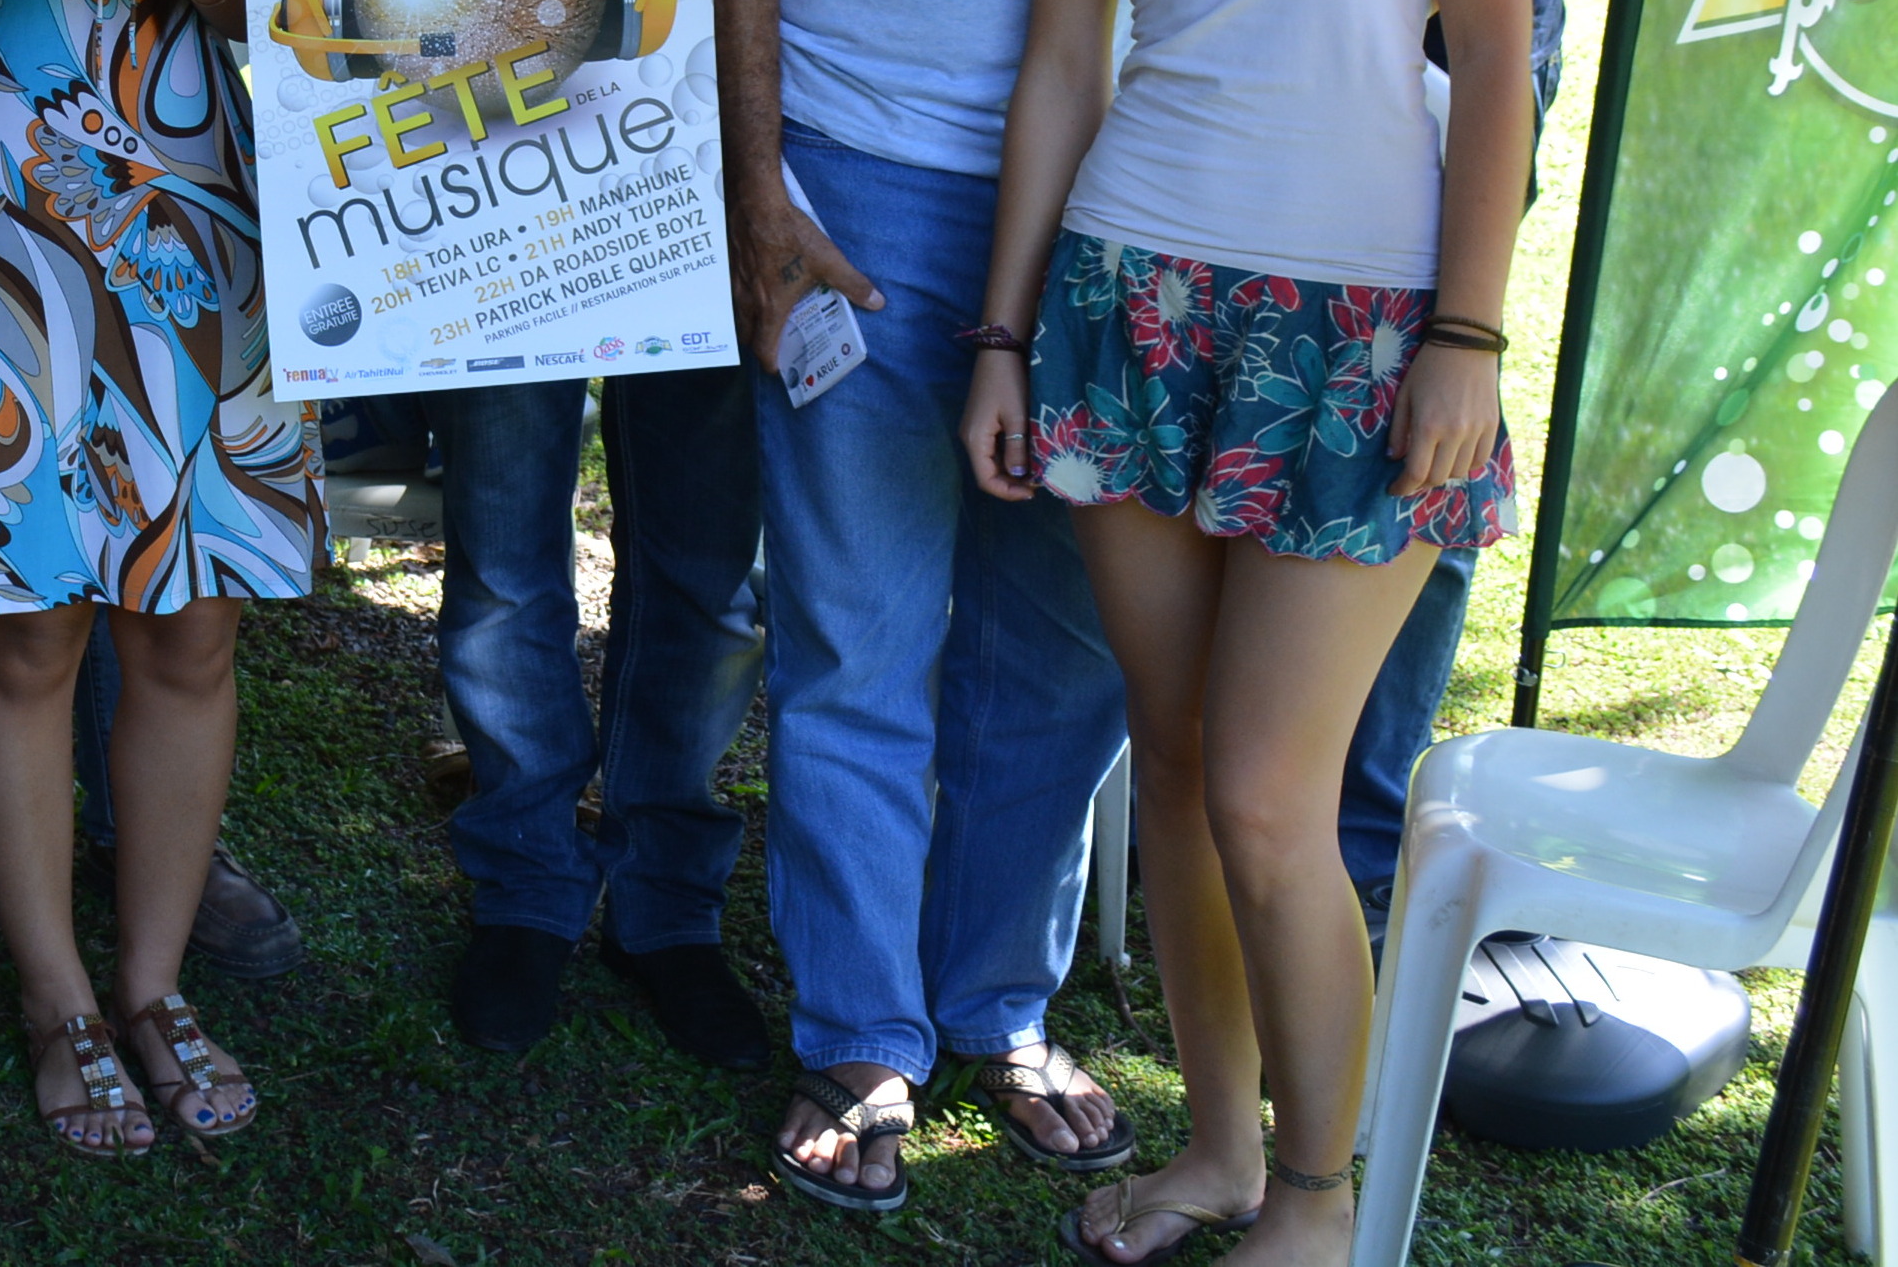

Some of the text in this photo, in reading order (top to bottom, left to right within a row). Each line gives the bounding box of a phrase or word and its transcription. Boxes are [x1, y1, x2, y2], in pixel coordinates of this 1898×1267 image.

[313, 41, 571, 189] FÊTE
[576, 81, 622, 106] DE LA
[296, 97, 676, 270] musique
[381, 164, 693, 286] 18H TOA URA 19H MANAHUNE
[371, 186, 699, 316] 20H TEIVA LC 21H ANDY TUPAÏA
[430, 231, 715, 346] 23H PATRICK NOBLE QUARTET
[474, 208, 708, 304] 22H DA ROADSIDE BOYZ
[304, 295, 356, 326] ENTREE
[308, 309, 361, 337] GRATUITE
[484, 320, 531, 344] PARKING
[532, 306, 569, 330] FACILE
[581, 275, 658, 310] RESTAURATION
[659, 267, 681, 284] SUR
[682, 254, 718, 276] PLACE
[681, 332, 712, 346] EDT
[815, 356, 840, 381] ARUE
